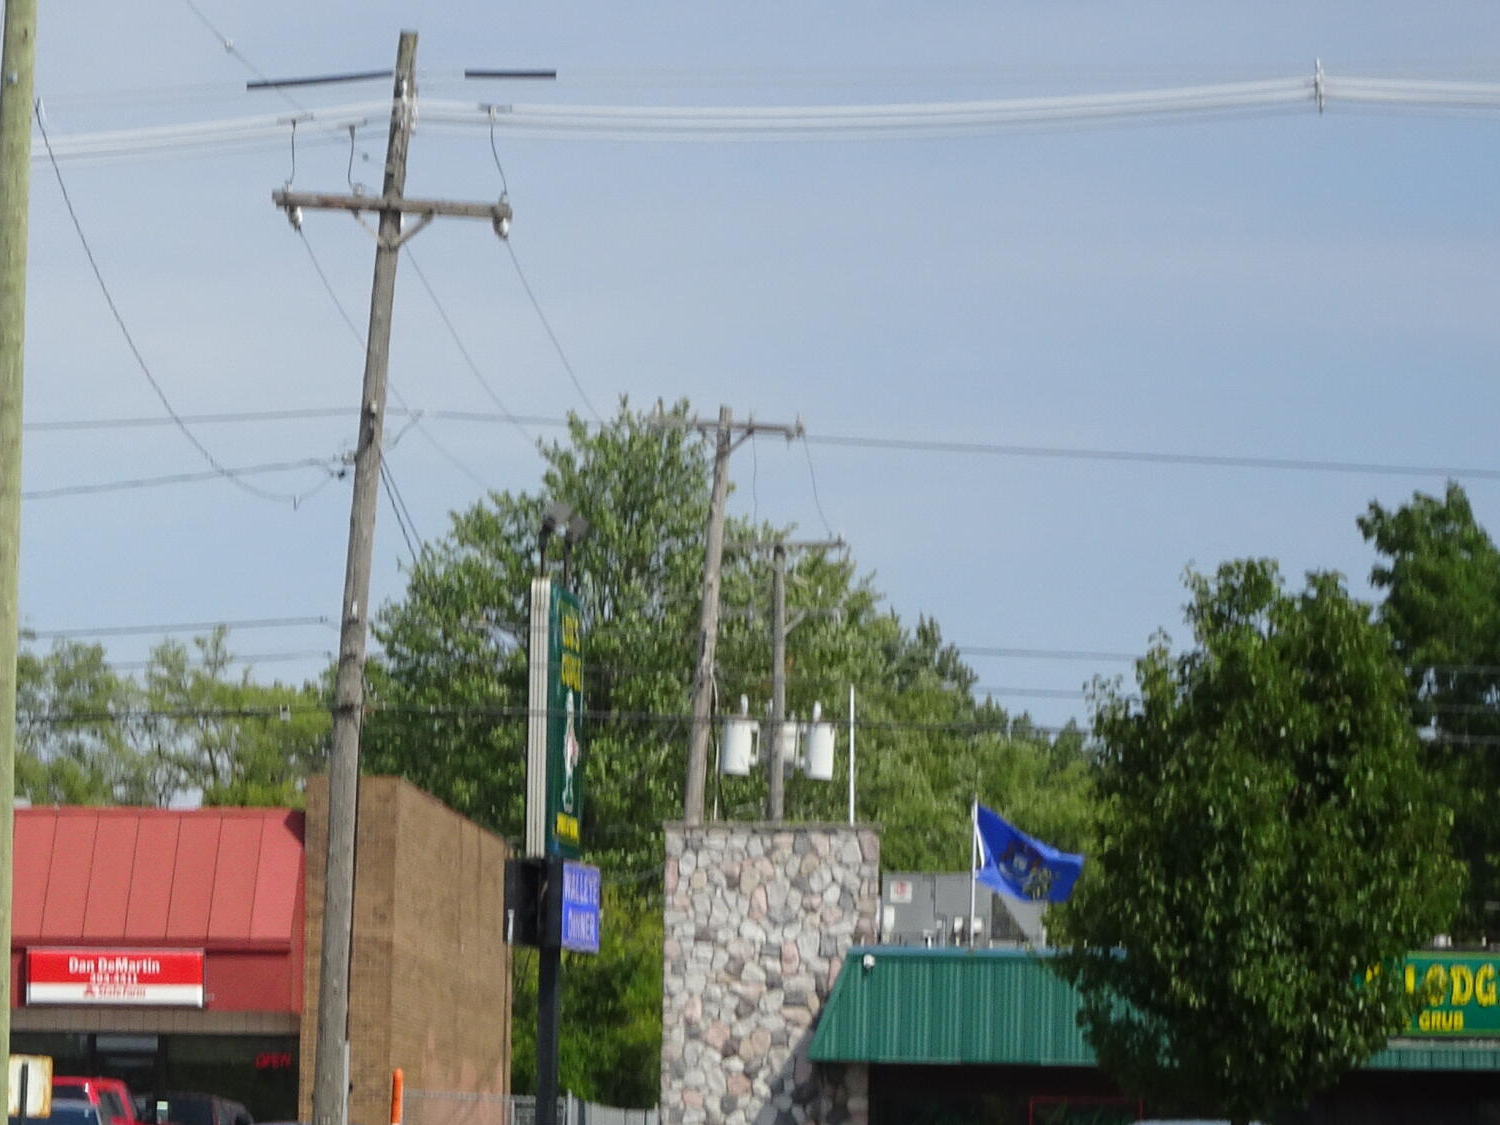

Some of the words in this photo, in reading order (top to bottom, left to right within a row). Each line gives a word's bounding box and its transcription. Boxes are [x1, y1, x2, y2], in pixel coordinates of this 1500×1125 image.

[563, 869, 598, 905] WALLEYE
[68, 956, 95, 974] Dan
[98, 956, 161, 974] DeMartin
[1404, 963, 1500, 1007] LODG
